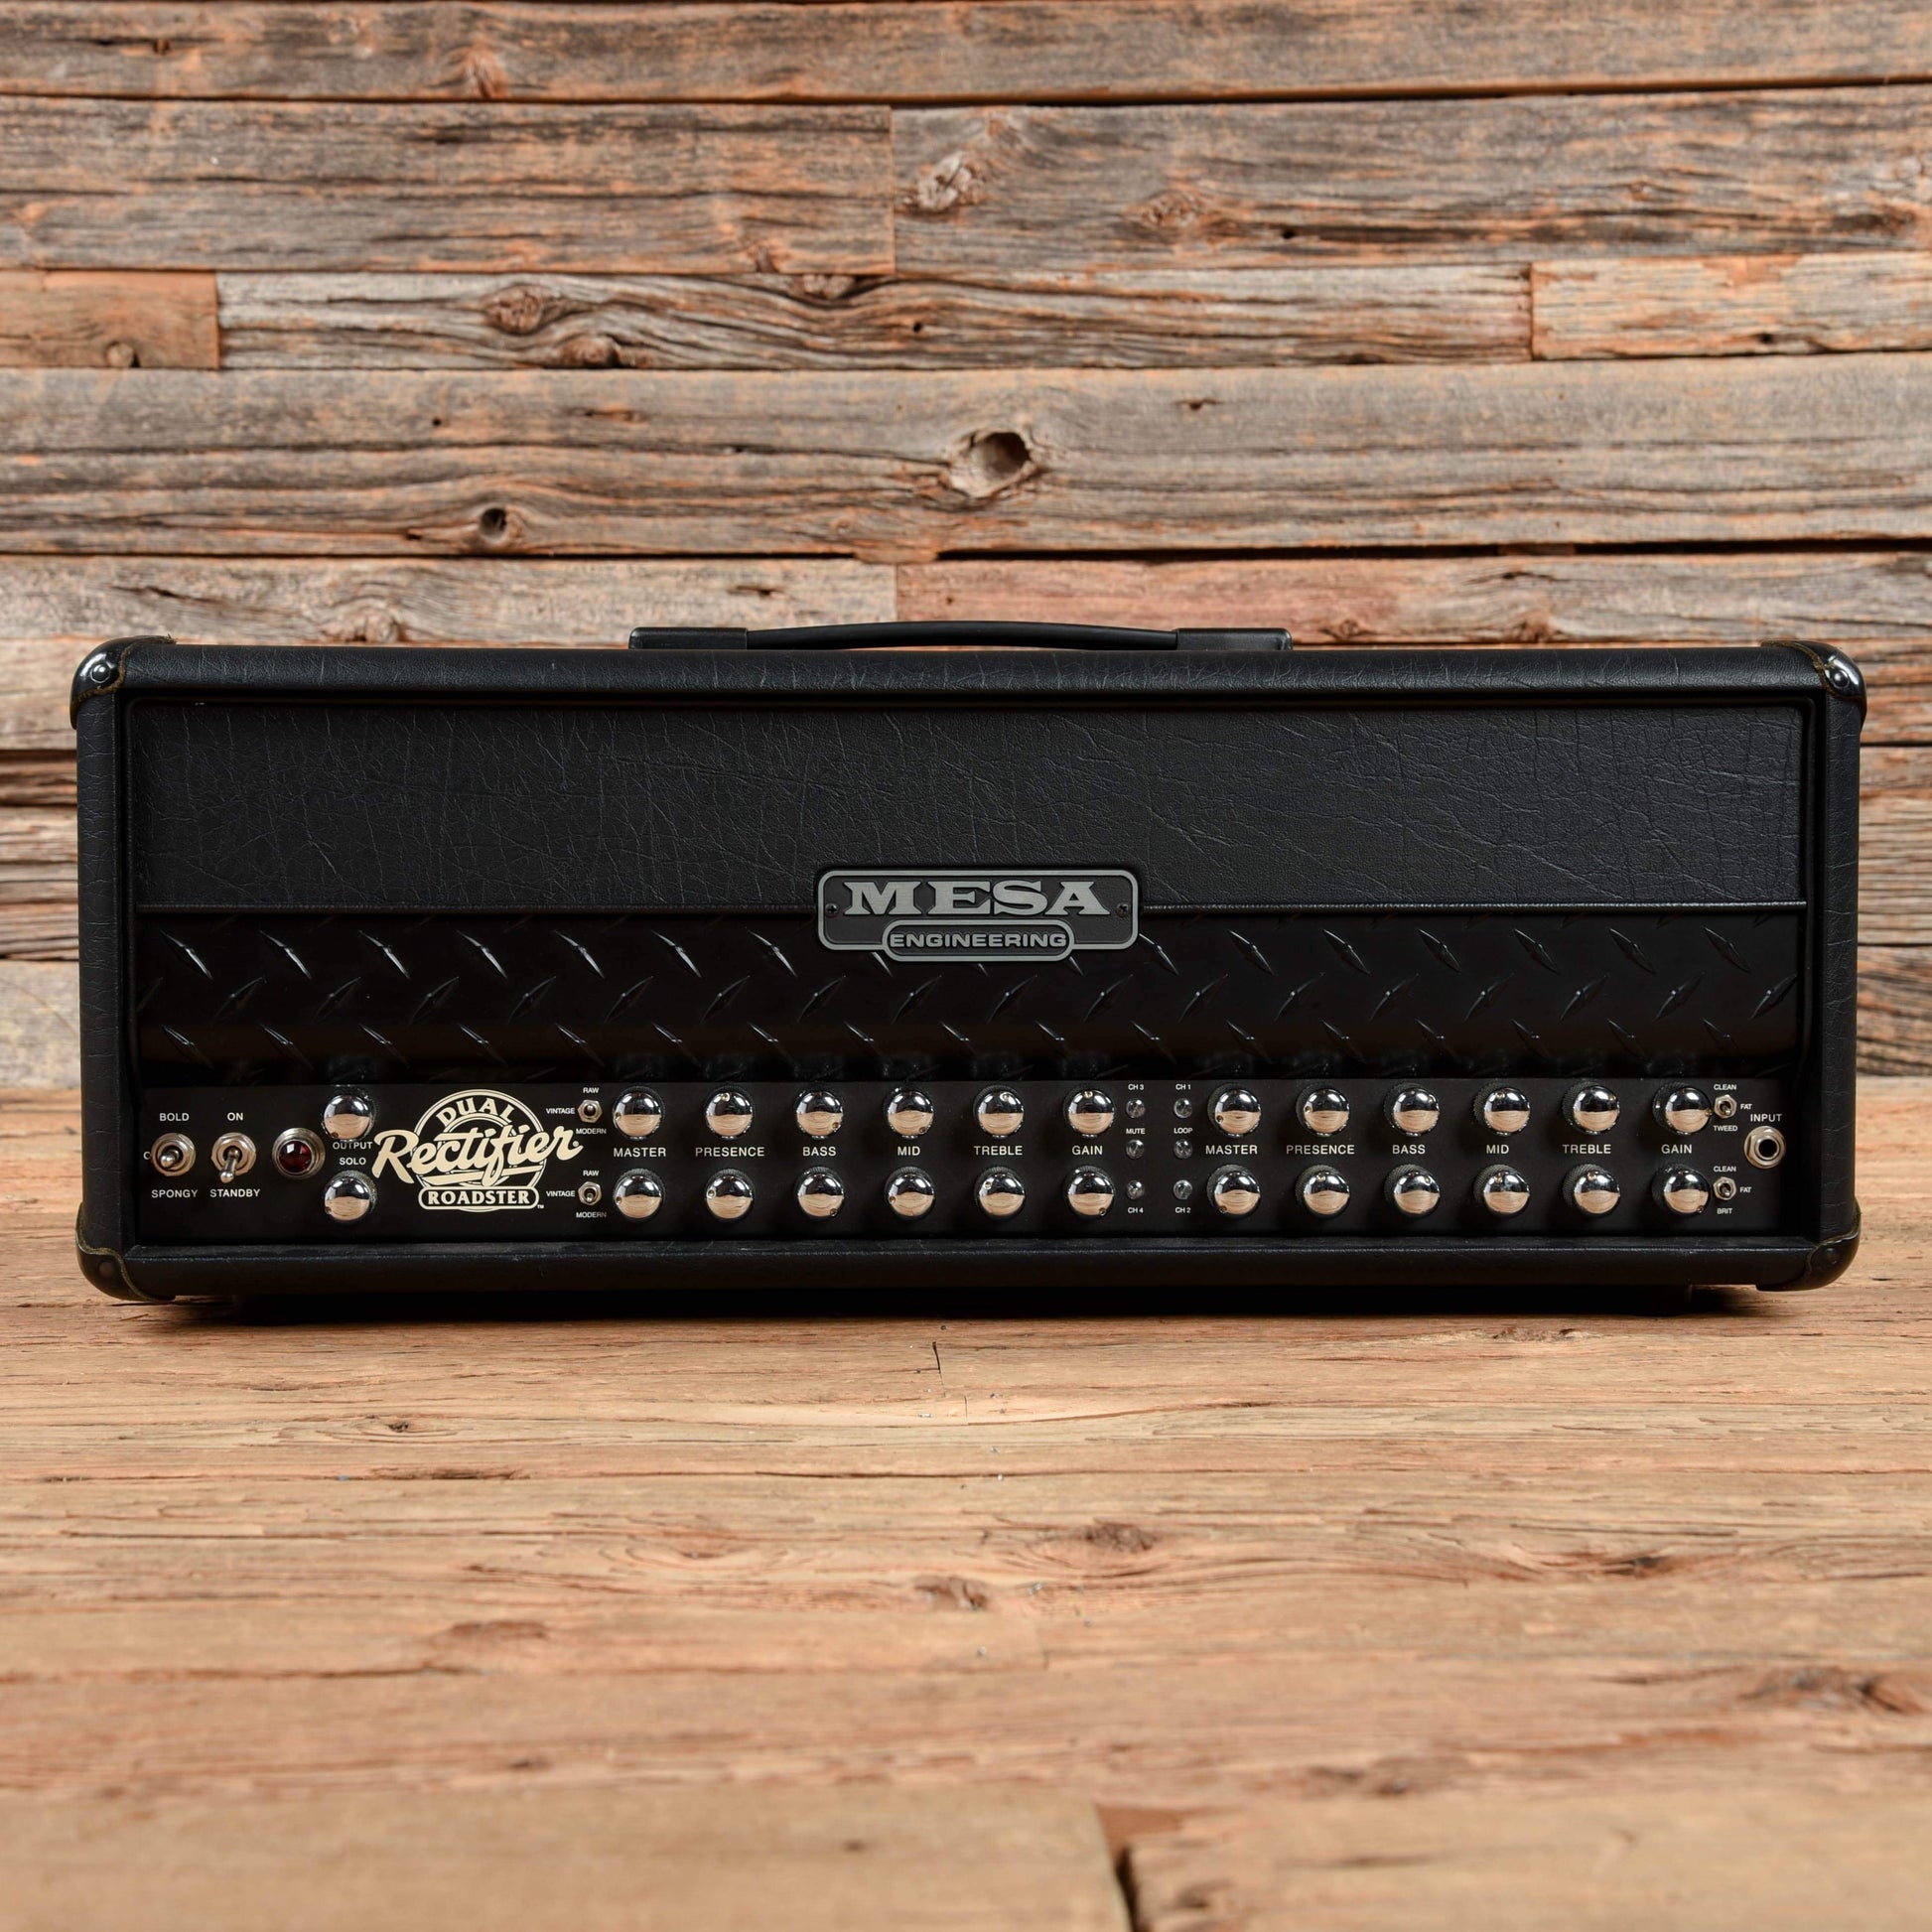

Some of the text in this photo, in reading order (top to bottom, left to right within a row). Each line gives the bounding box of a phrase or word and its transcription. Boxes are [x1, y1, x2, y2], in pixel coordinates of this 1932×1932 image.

[844, 880, 1111, 916] MESA
[890, 933, 1067, 948] ENGINEERING
[437, 1097, 515, 1128] DUAL
[614, 1148, 666, 1157] MASTER
[695, 1147, 764, 1157] PRESENCE
[802, 1146, 837, 1156] BASS
[897, 1146, 920, 1156] MID
[974, 1146, 1023, 1156] TREBLE
[1072, 1146, 1103, 1155] GAIN
[1205, 1145, 1258, 1155] MASTER
[1287, 1145, 1355, 1155] PRESENCE
[1392, 1145, 1426, 1154] BASS
[1486, 1145, 1509, 1154] MID
[1563, 1145, 1611, 1154] TREBLE
[1661, 1145, 1693, 1154] GAIN
[371, 1125, 584, 1187] Rectifier
[339, 1157, 366, 1166] SOLO
[151, 1189, 198, 1198] SPONGY
[209, 1188, 260, 1197] STANDBY
[428, 1190, 530, 1205] ROADSTER
